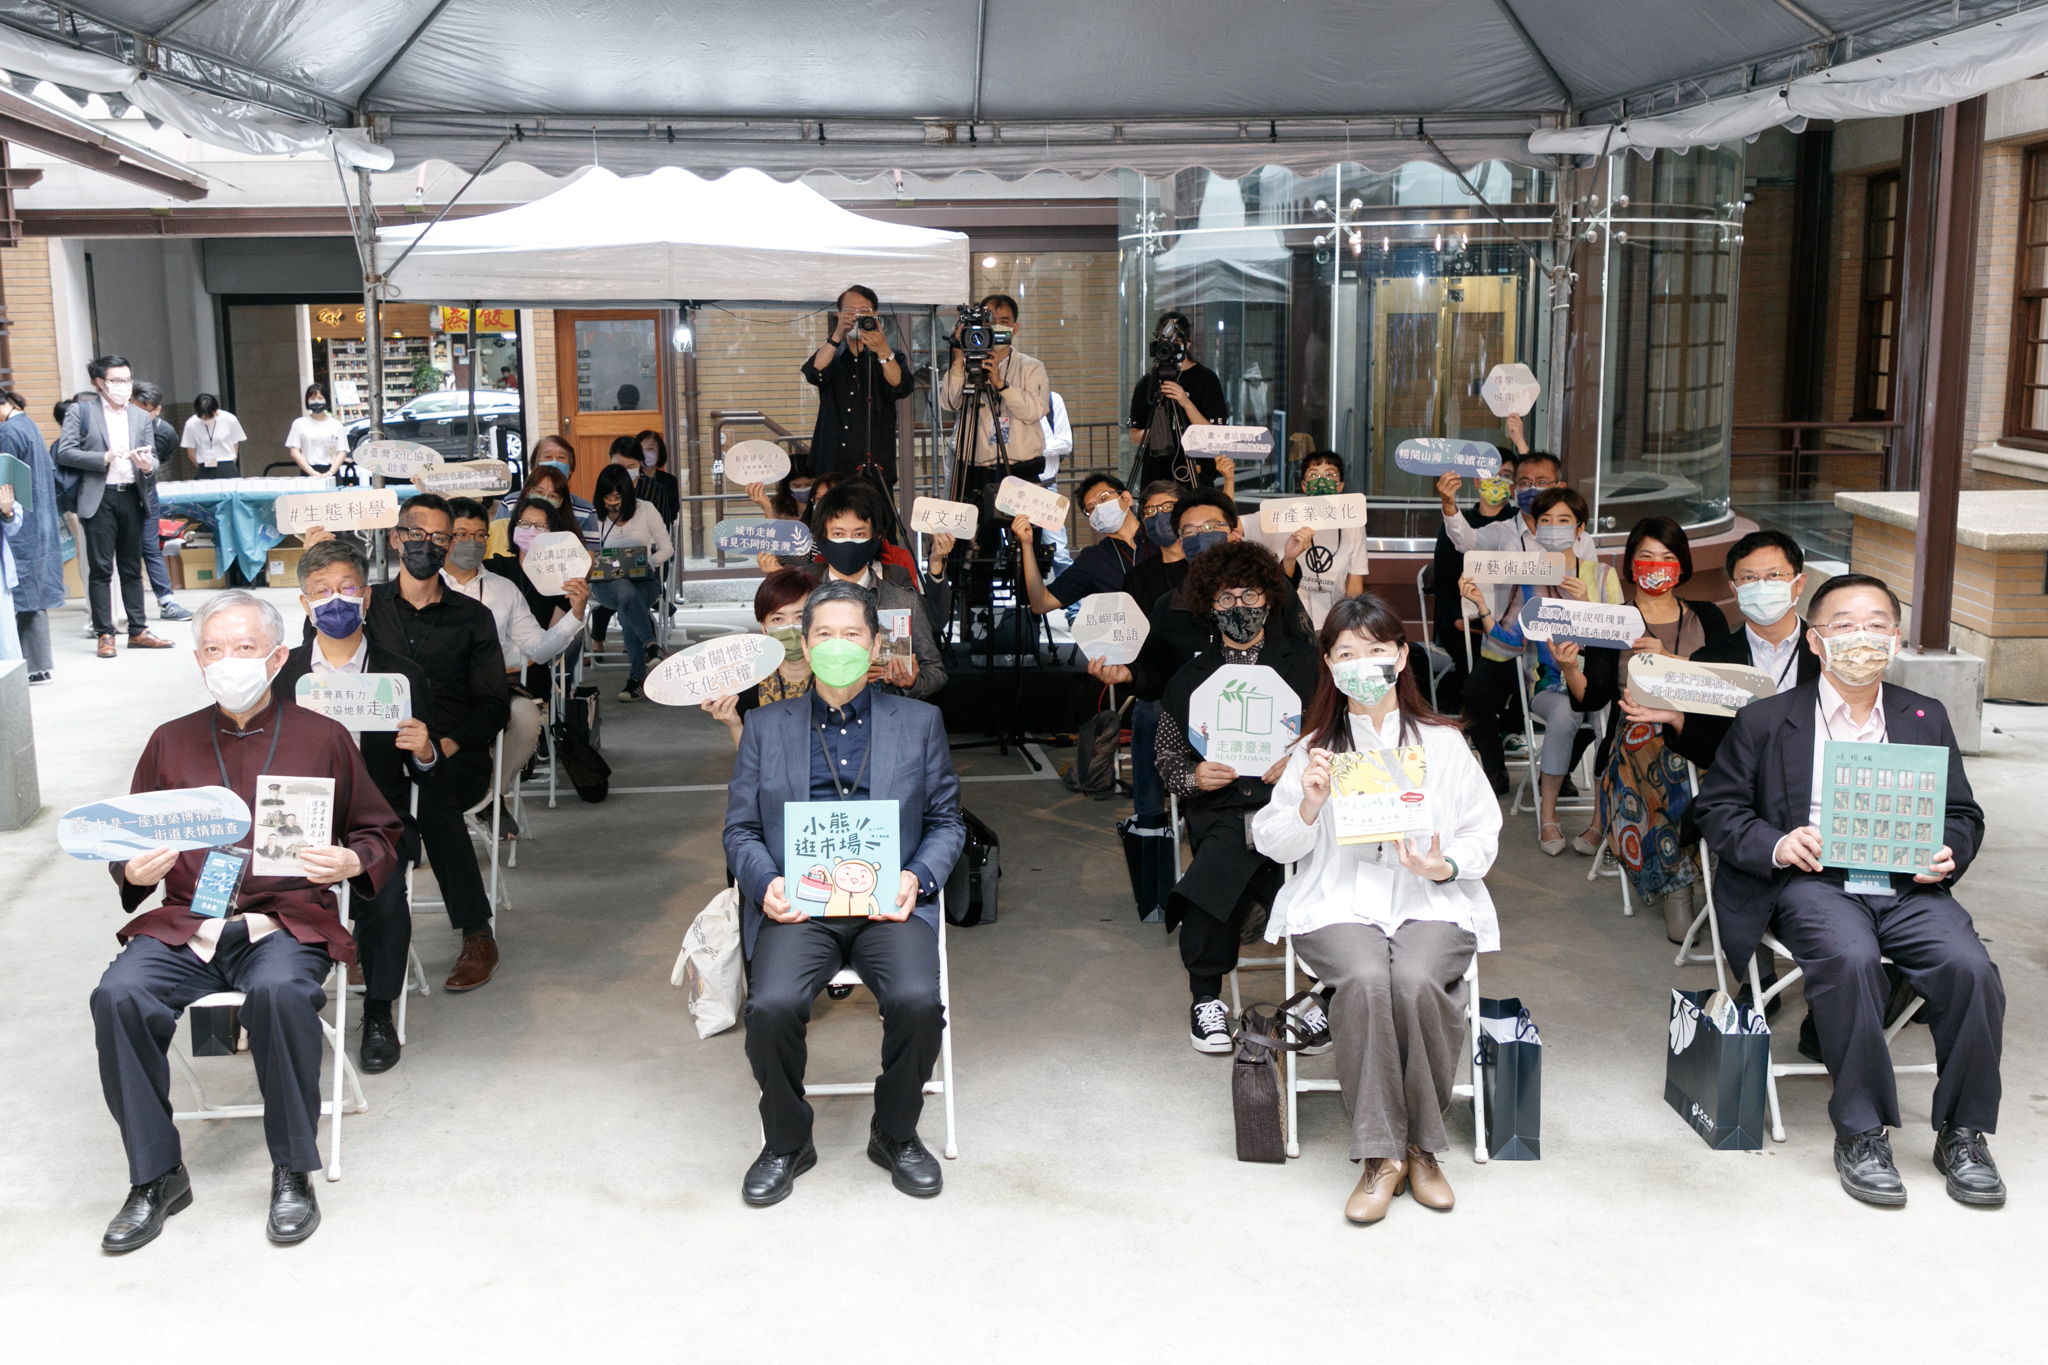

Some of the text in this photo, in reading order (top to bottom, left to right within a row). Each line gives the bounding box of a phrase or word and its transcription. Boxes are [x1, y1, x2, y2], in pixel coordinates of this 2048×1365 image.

[446, 307, 511, 330] 蒸餃
[362, 448, 435, 463] #臺灣文化協會
[289, 500, 386, 523] #生態科學
[921, 509, 968, 530] #文史
[1271, 503, 1357, 523] #產業文化
[735, 525, 776, 538] 城市走繪
[720, 536, 791, 552] 看見不同的臺灣
[533, 562, 567, 576] 家鄉事
[1474, 560, 1555, 577] #藝術設計
[1086, 612, 1126, 626] 島嶼啊
[1538, 606, 1627, 626] 臺灣傳統說唱瑰寶
[1113, 628, 1138, 642] 島語
[664, 638, 762, 681] #社會關懷或
[683, 662, 754, 699] 文化平權
[311, 689, 366, 700] 臺灣真有力
[322, 699, 400, 719] 文協地景走讀
[1216, 740, 1272, 755] 走讀臺灣
[71, 808, 223, 836] 臺中是一座建築博物館
[803, 812, 850, 836] 小熊
[795, 833, 861, 859] 逛市場
